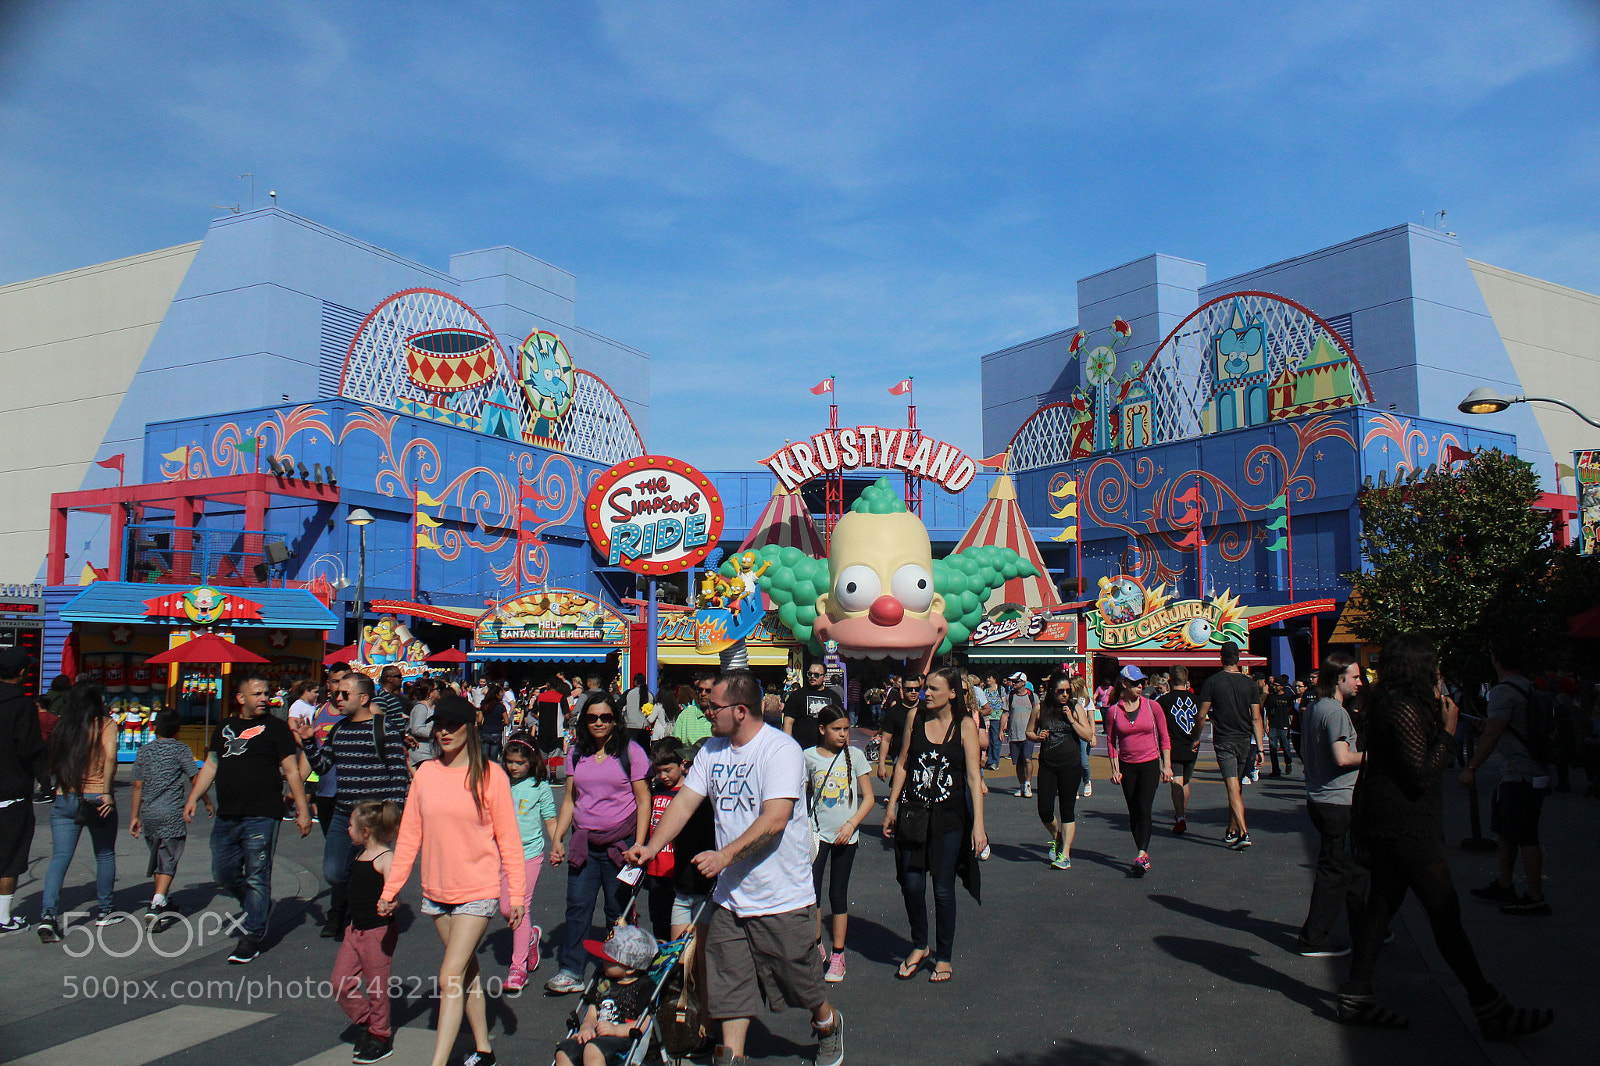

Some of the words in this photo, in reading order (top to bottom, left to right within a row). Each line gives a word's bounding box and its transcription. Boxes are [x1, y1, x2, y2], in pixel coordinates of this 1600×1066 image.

[824, 380, 831, 392] K
[902, 381, 910, 392] K
[769, 426, 977, 492] KRUSTYLAND
[609, 513, 709, 566] RIDE
[538, 621, 562, 629] HELP
[974, 619, 1019, 640] Strike
[1029, 615, 1042, 634] 3
[1102, 627, 1137, 644] EYE
[1137, 602, 1221, 637] CARUMBA!
[501, 630, 536, 638] SANTA'S
[538, 630, 566, 638] LITTLE
[568, 630, 600, 638] HELPER
[699, 629, 711, 646] K
